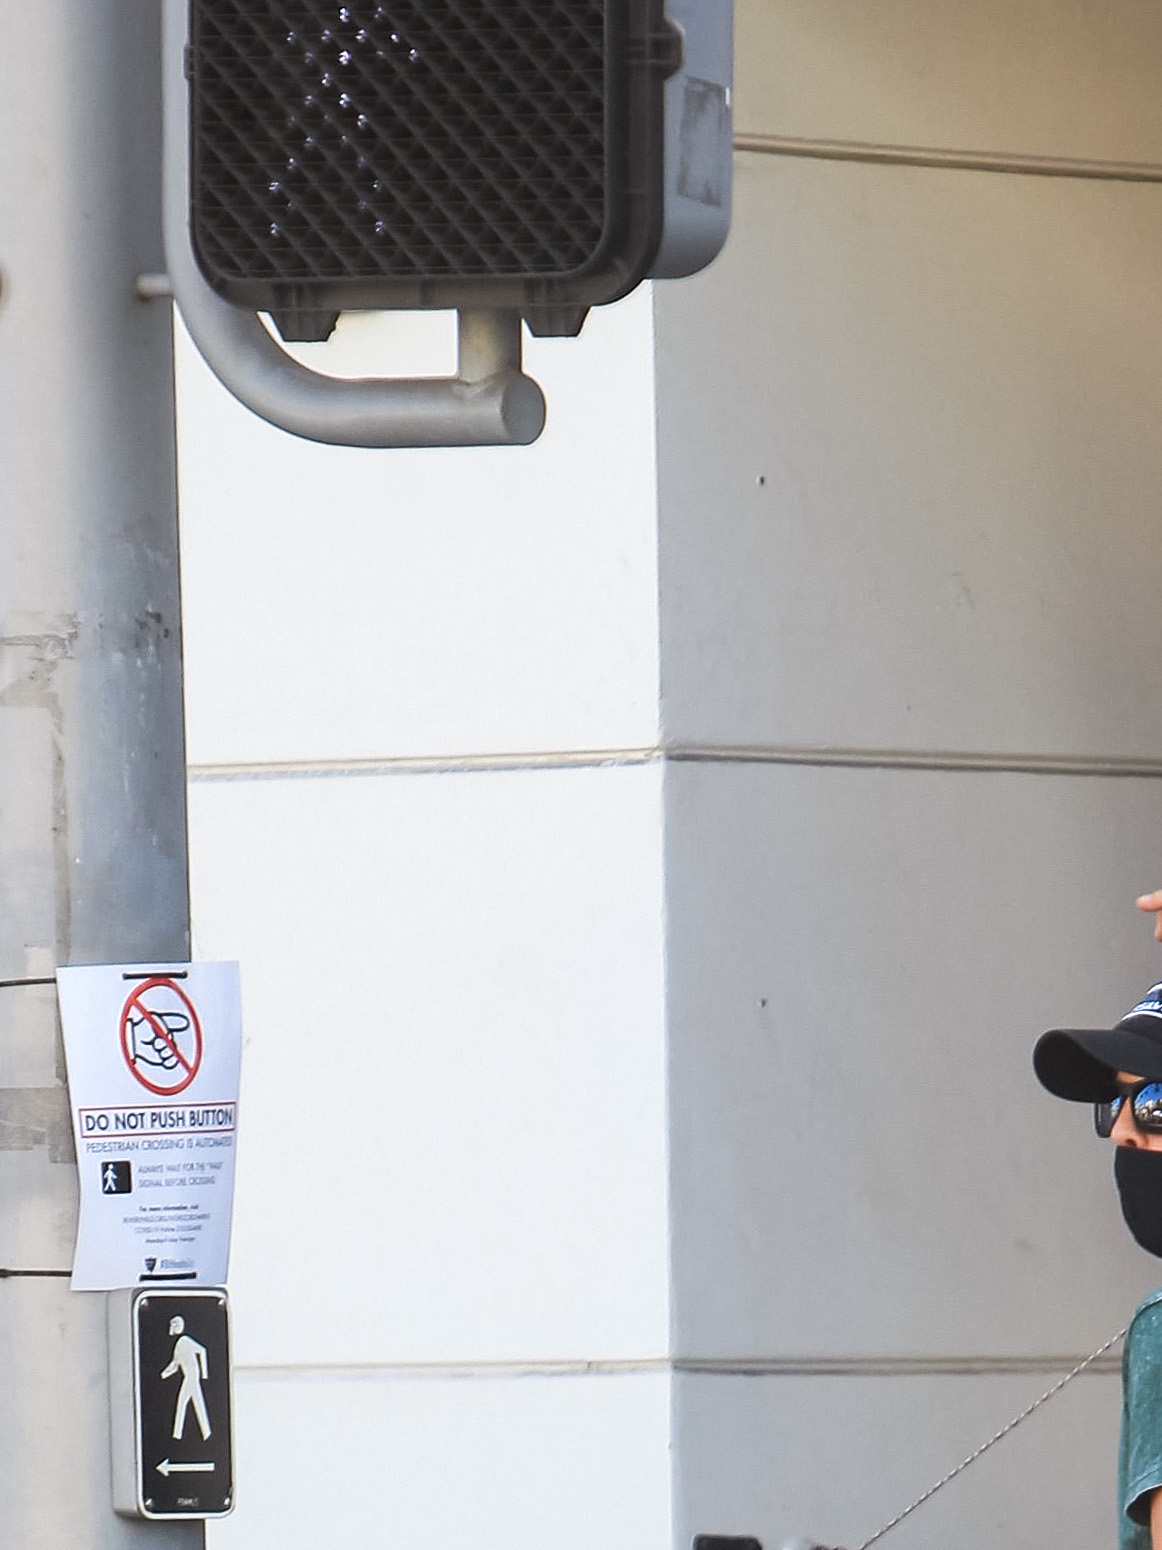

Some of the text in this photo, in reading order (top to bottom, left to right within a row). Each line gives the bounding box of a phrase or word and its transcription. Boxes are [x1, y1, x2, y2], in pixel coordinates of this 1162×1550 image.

[85, 1107, 233, 1131] DO NOT PUSH BUTTON
[86, 1140, 139, 1153] PEDESTRIAN
[141, 1138, 185, 1151] CROSSING
